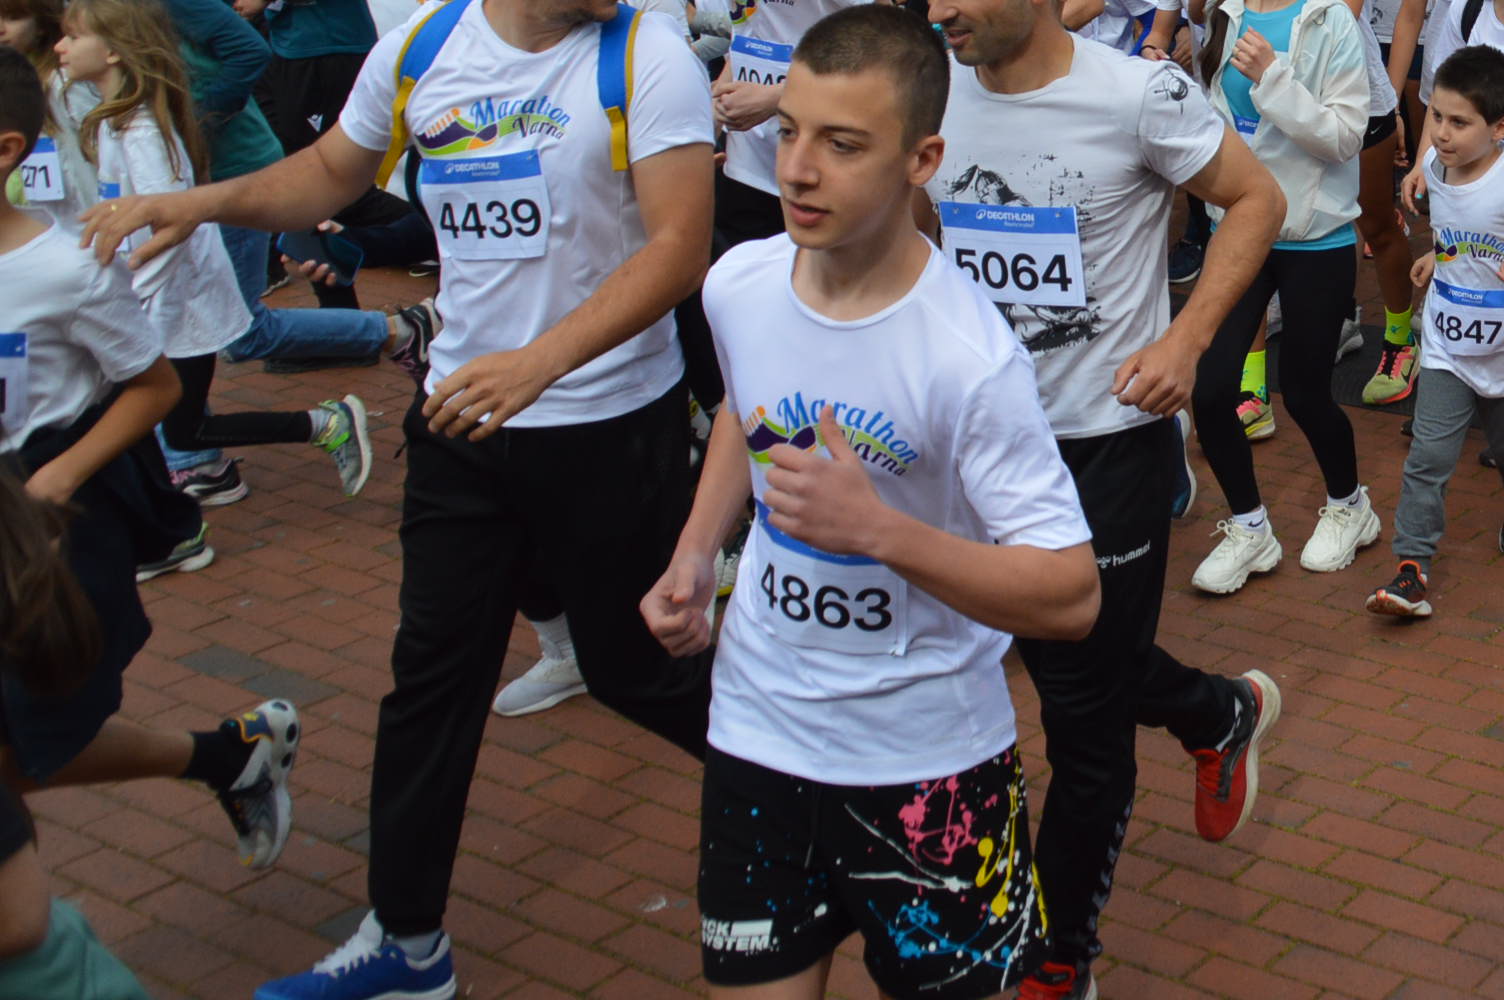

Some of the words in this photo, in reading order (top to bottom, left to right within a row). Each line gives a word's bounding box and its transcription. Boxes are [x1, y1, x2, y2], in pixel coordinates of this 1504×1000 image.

[511, 115, 567, 140] Varna
[440, 198, 542, 239] 4439
[986, 209, 1035, 222] DECATHLON
[955, 248, 1073, 292] 5064
[1435, 311, 1503, 345] 4847
[1112, 539, 1151, 567] hummel
[761, 562, 893, 632] 4863
